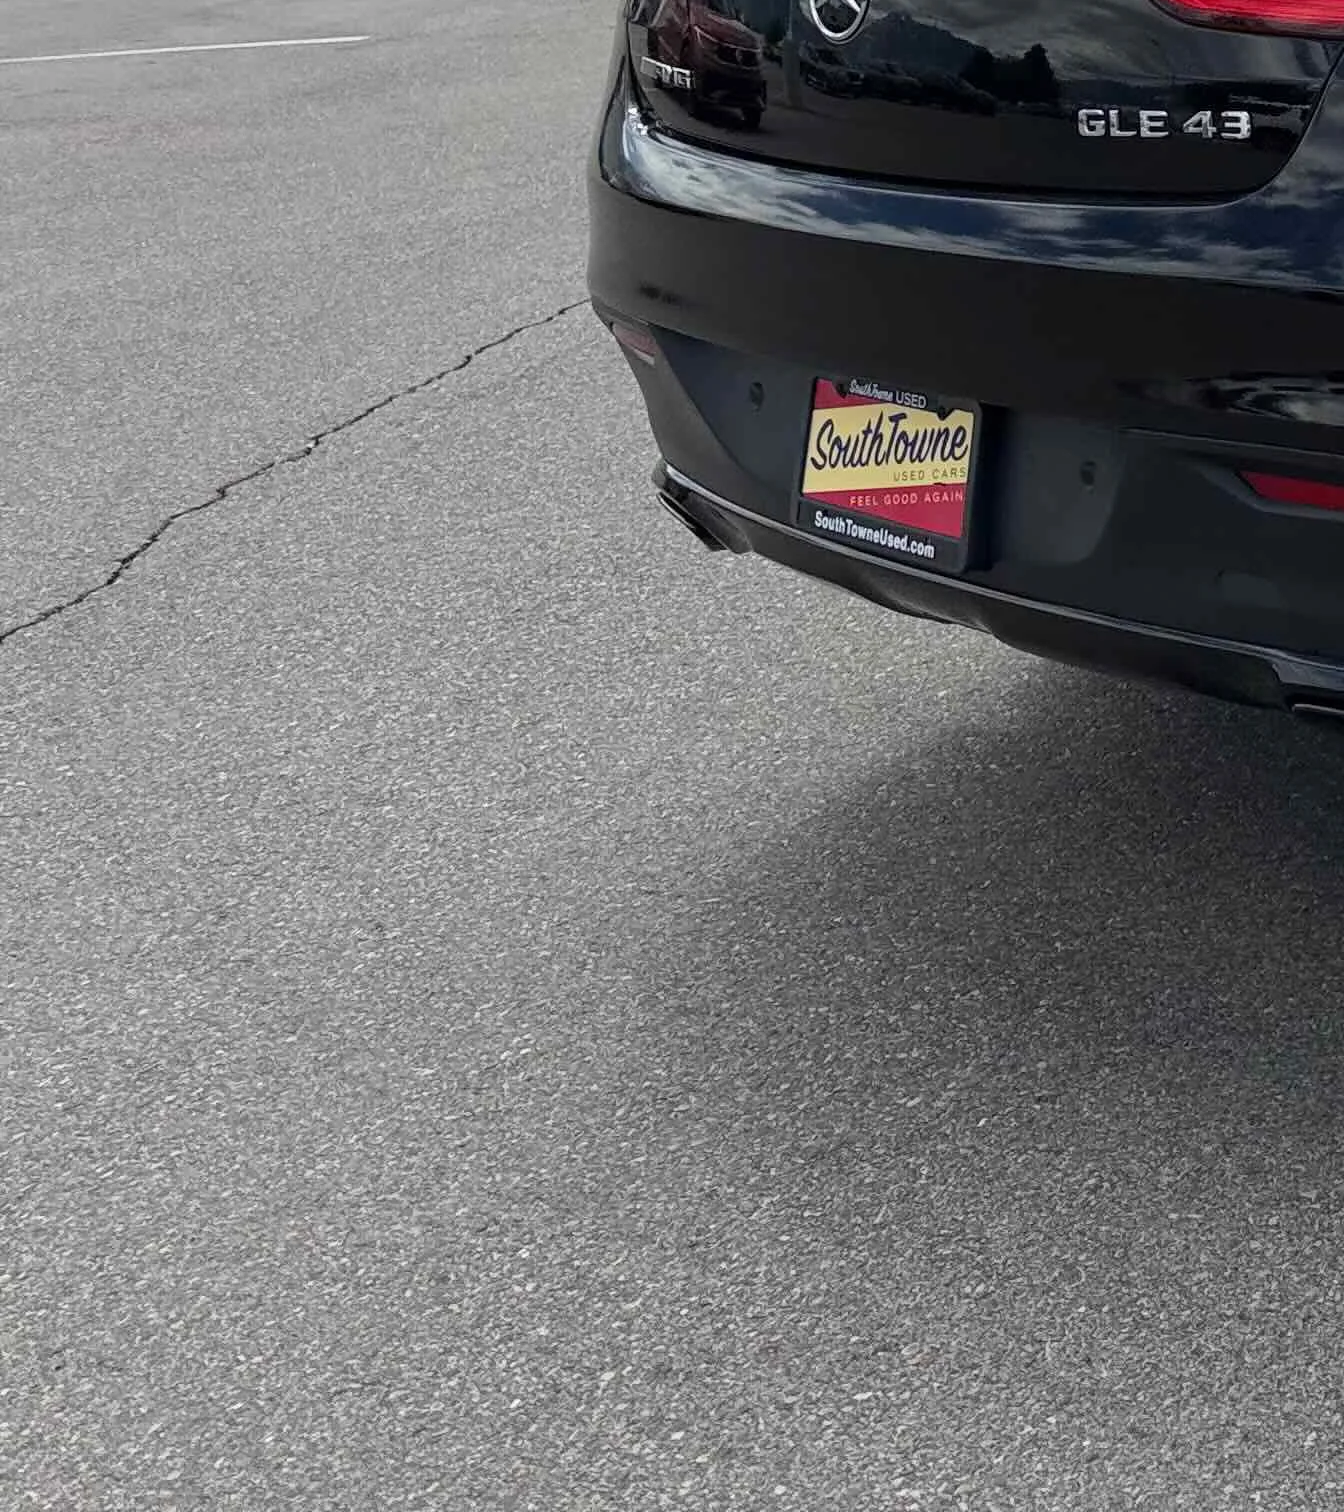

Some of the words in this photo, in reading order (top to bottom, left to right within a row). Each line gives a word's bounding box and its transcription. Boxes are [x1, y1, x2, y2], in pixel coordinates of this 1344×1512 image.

[1077, 108, 1169, 138] GLE
[1183, 110, 1251, 139] 43
[895, 390, 927, 409] USED
[810, 411, 969, 471] SouthTowne
[893, 472, 926, 482] USED
[931, 467, 966, 479] CARS
[850, 495, 879, 507] FEEL
[883, 493, 919, 506] GOOD
[923, 490, 963, 503] AGAIN
[814, 509, 935, 559] SouthTowneUsed.com
